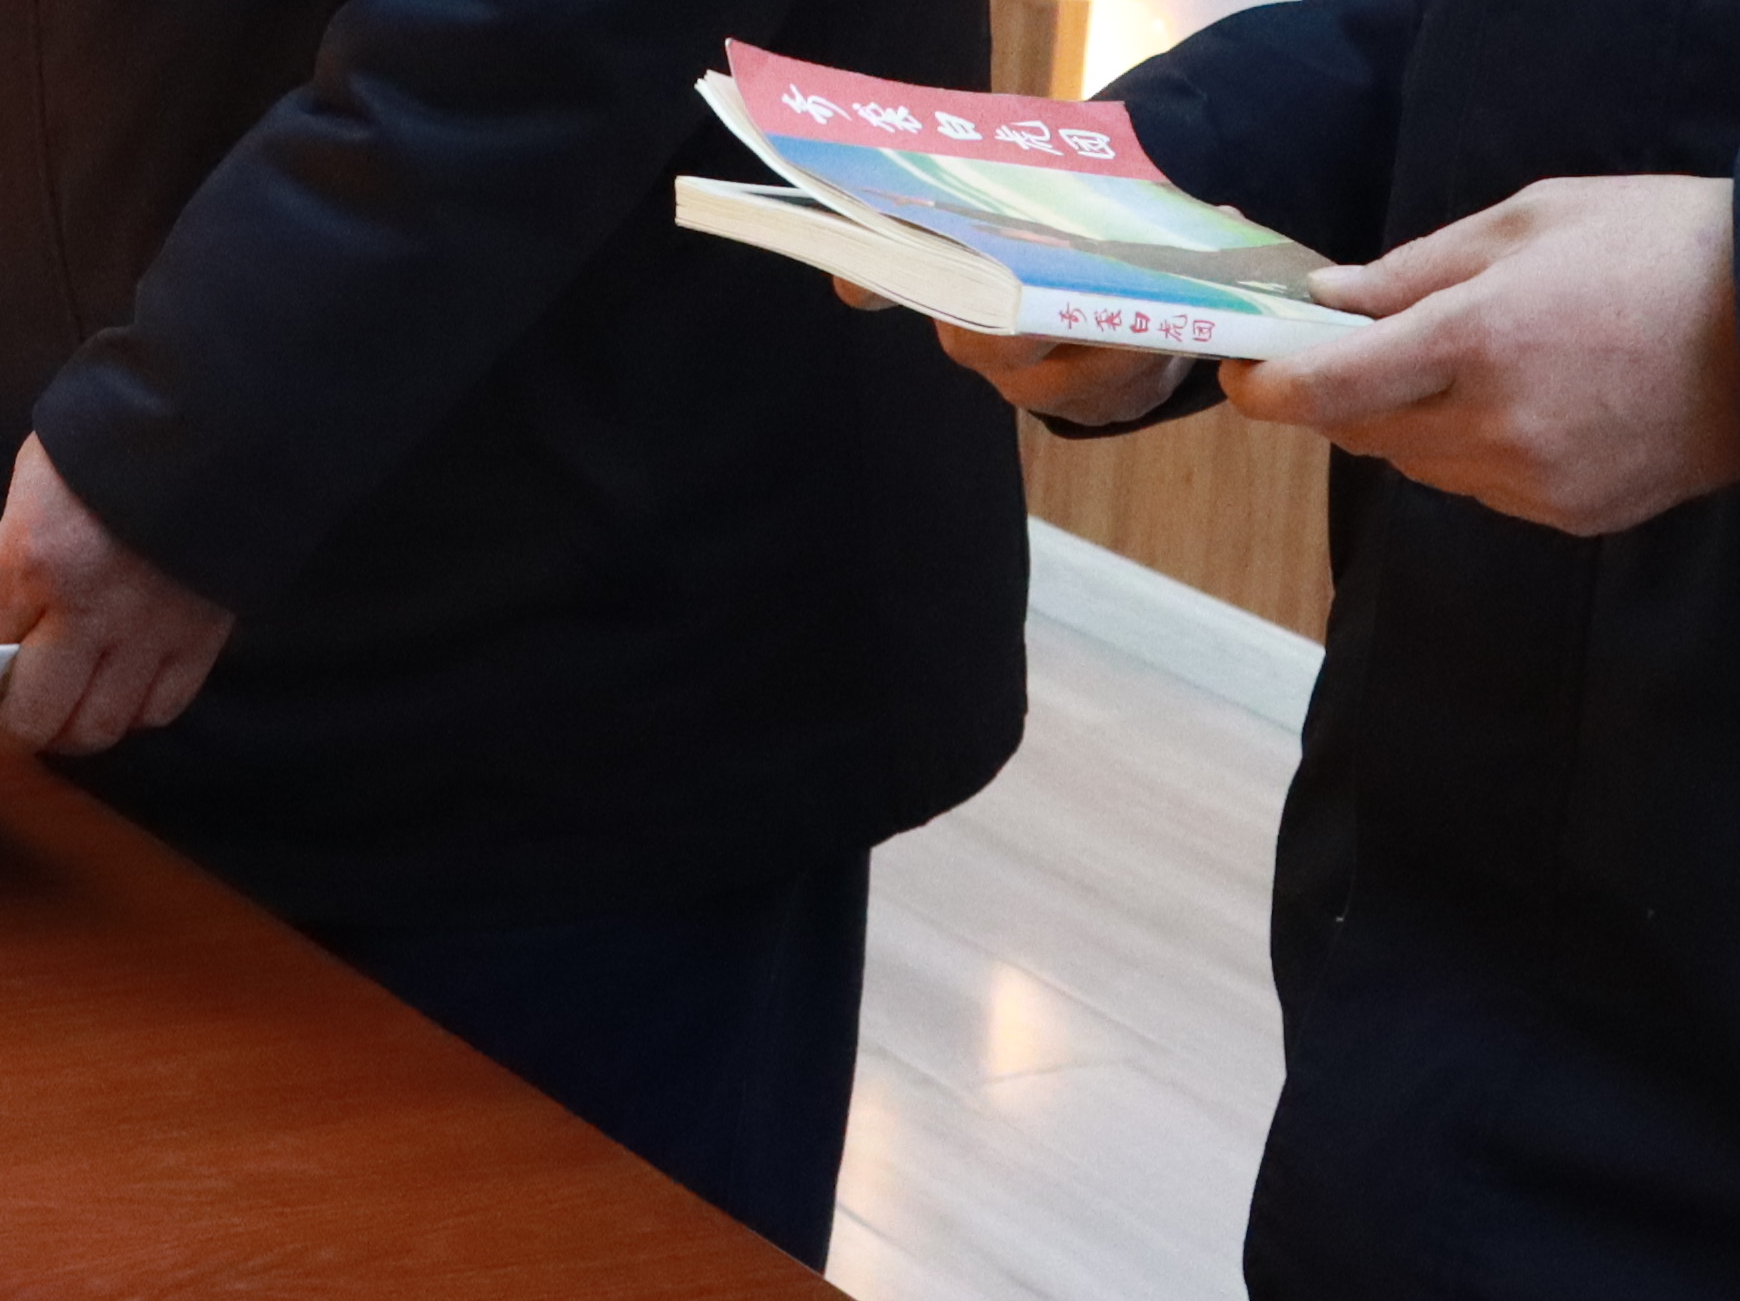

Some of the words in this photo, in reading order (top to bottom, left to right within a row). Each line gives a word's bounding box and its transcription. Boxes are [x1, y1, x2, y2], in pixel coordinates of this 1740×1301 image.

[780, 83, 1119, 160] 奇袭白虎团
[1057, 302, 1217, 345] 奇袭白虎团
